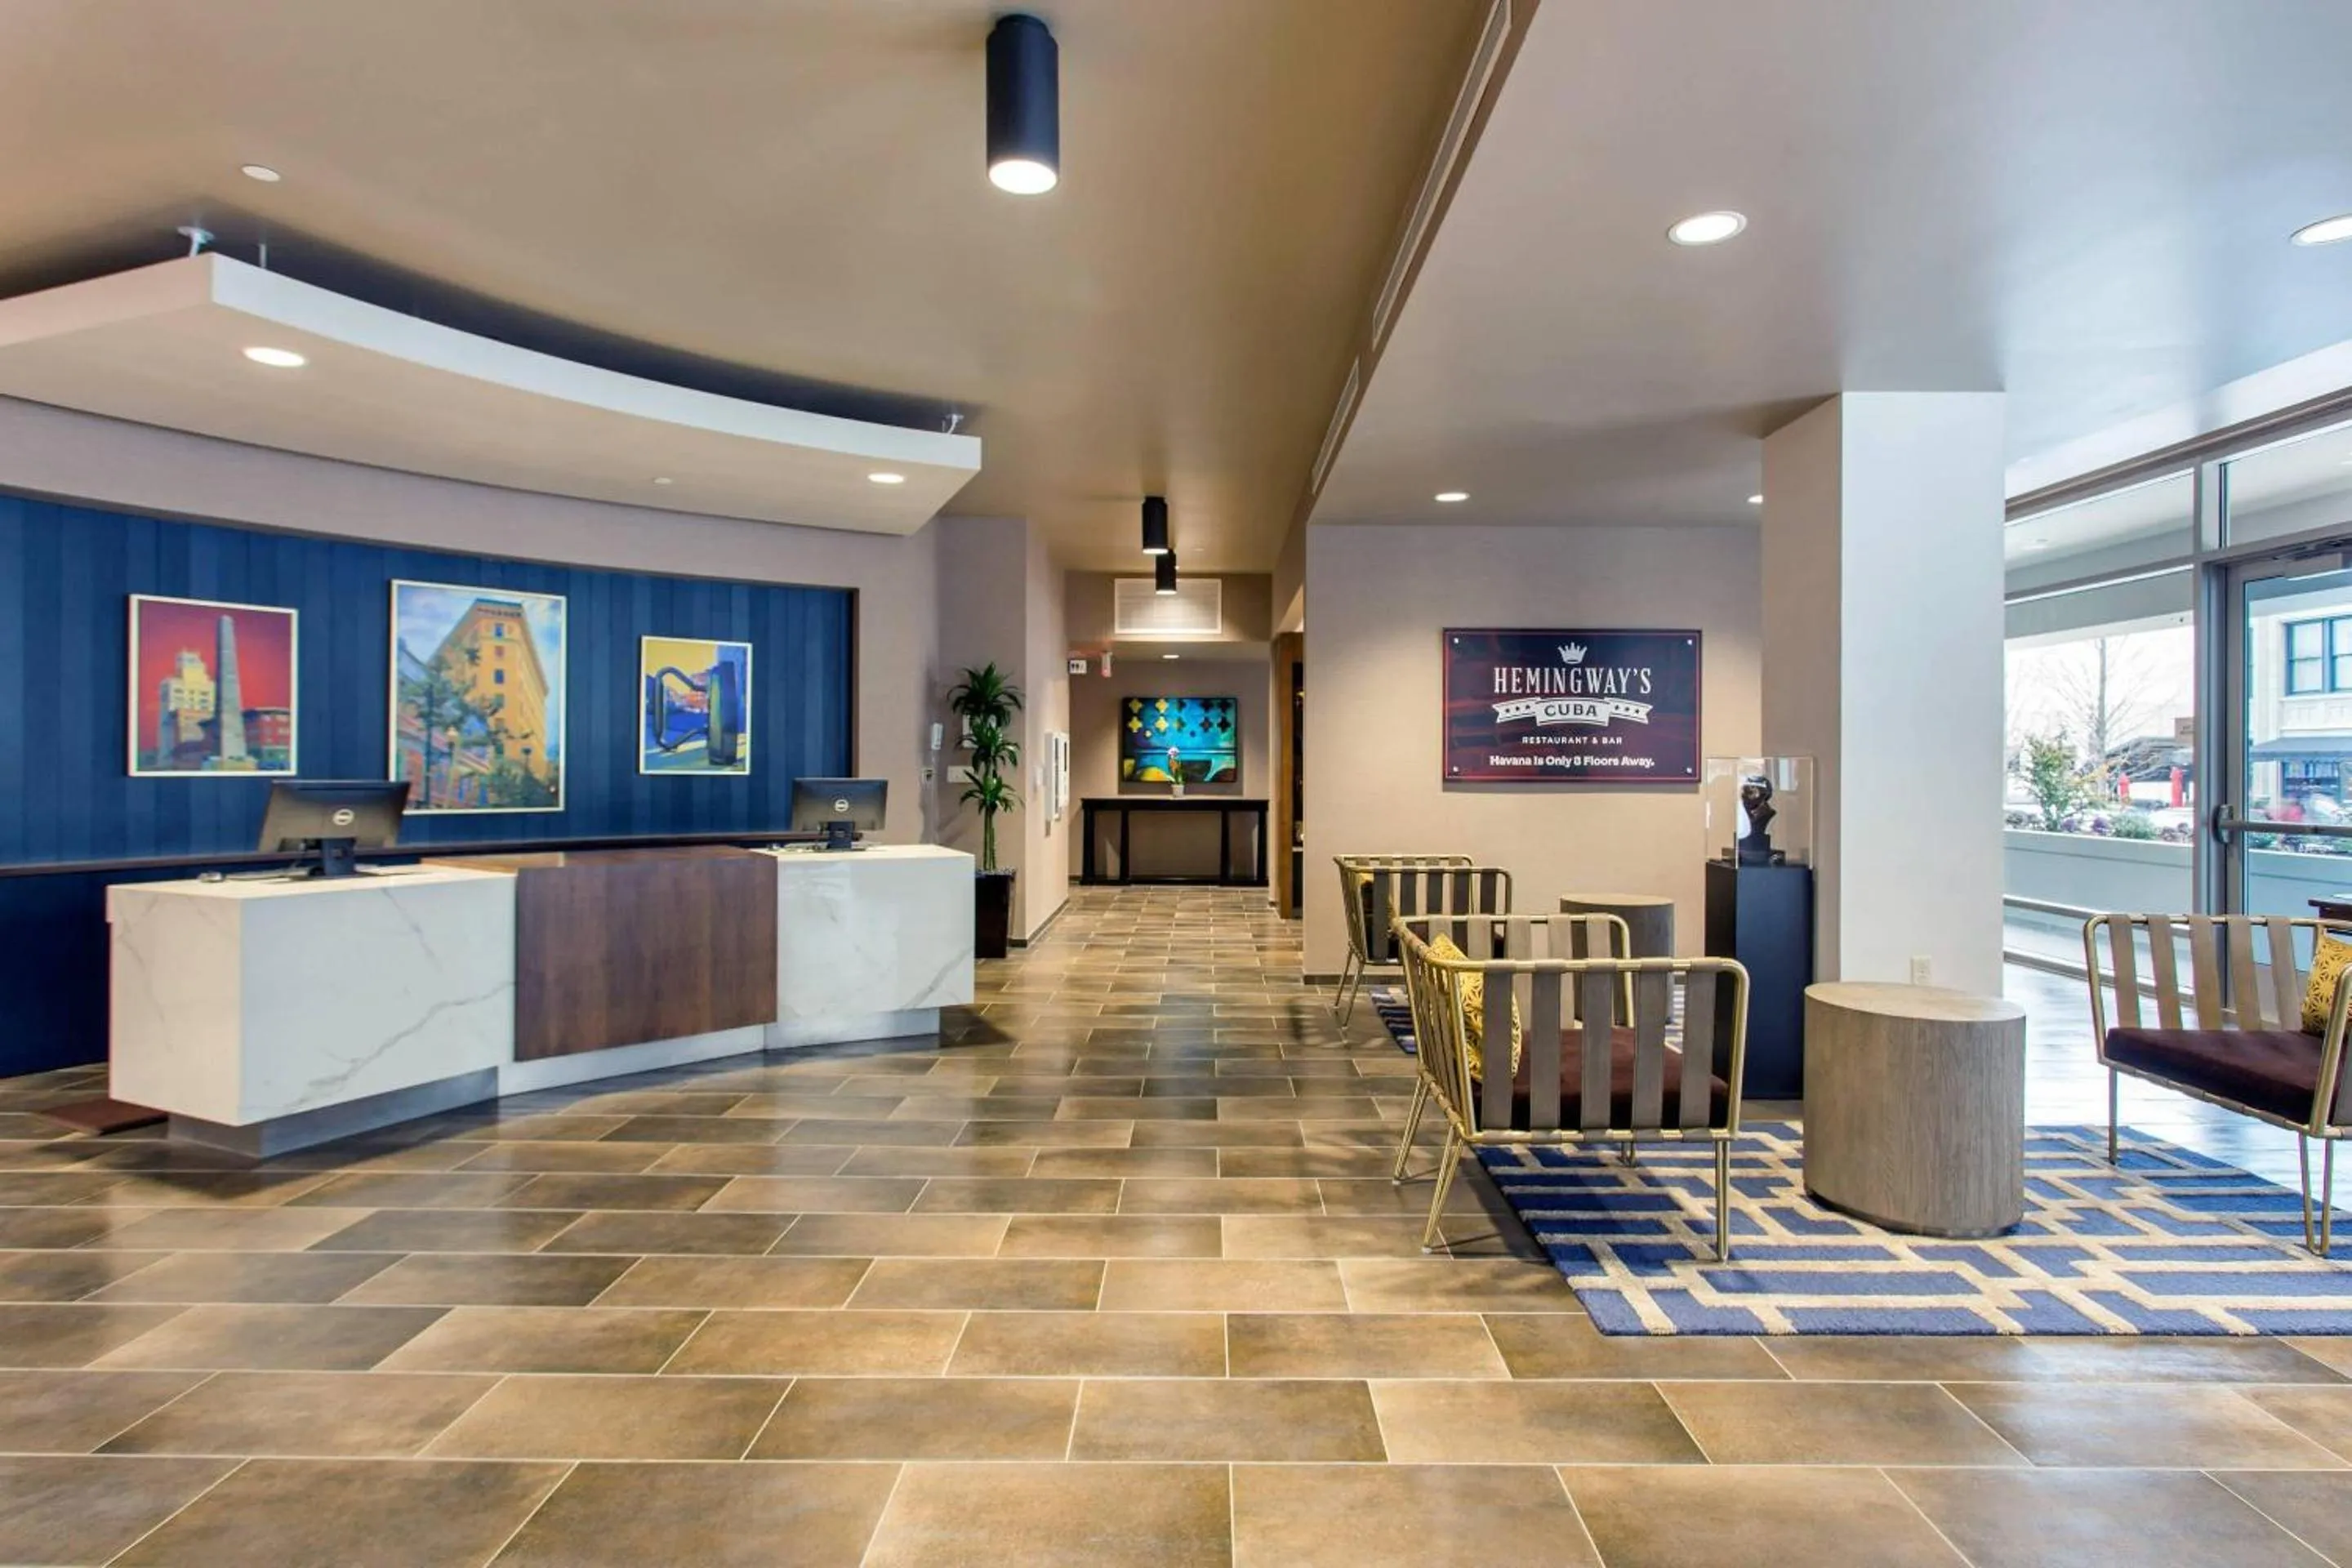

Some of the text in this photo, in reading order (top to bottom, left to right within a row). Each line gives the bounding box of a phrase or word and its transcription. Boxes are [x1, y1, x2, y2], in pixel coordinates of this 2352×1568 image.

[1494, 666, 1651, 694] HEMINGWAY'S
[1544, 703, 1597, 717] CUBA
[1489, 755, 1532, 765] Havana
[1534, 755, 1544, 765] Is
[1545, 755, 1572, 768] Only
[1583, 755, 1619, 765] Floors
[1621, 755, 1655, 768] Away.
